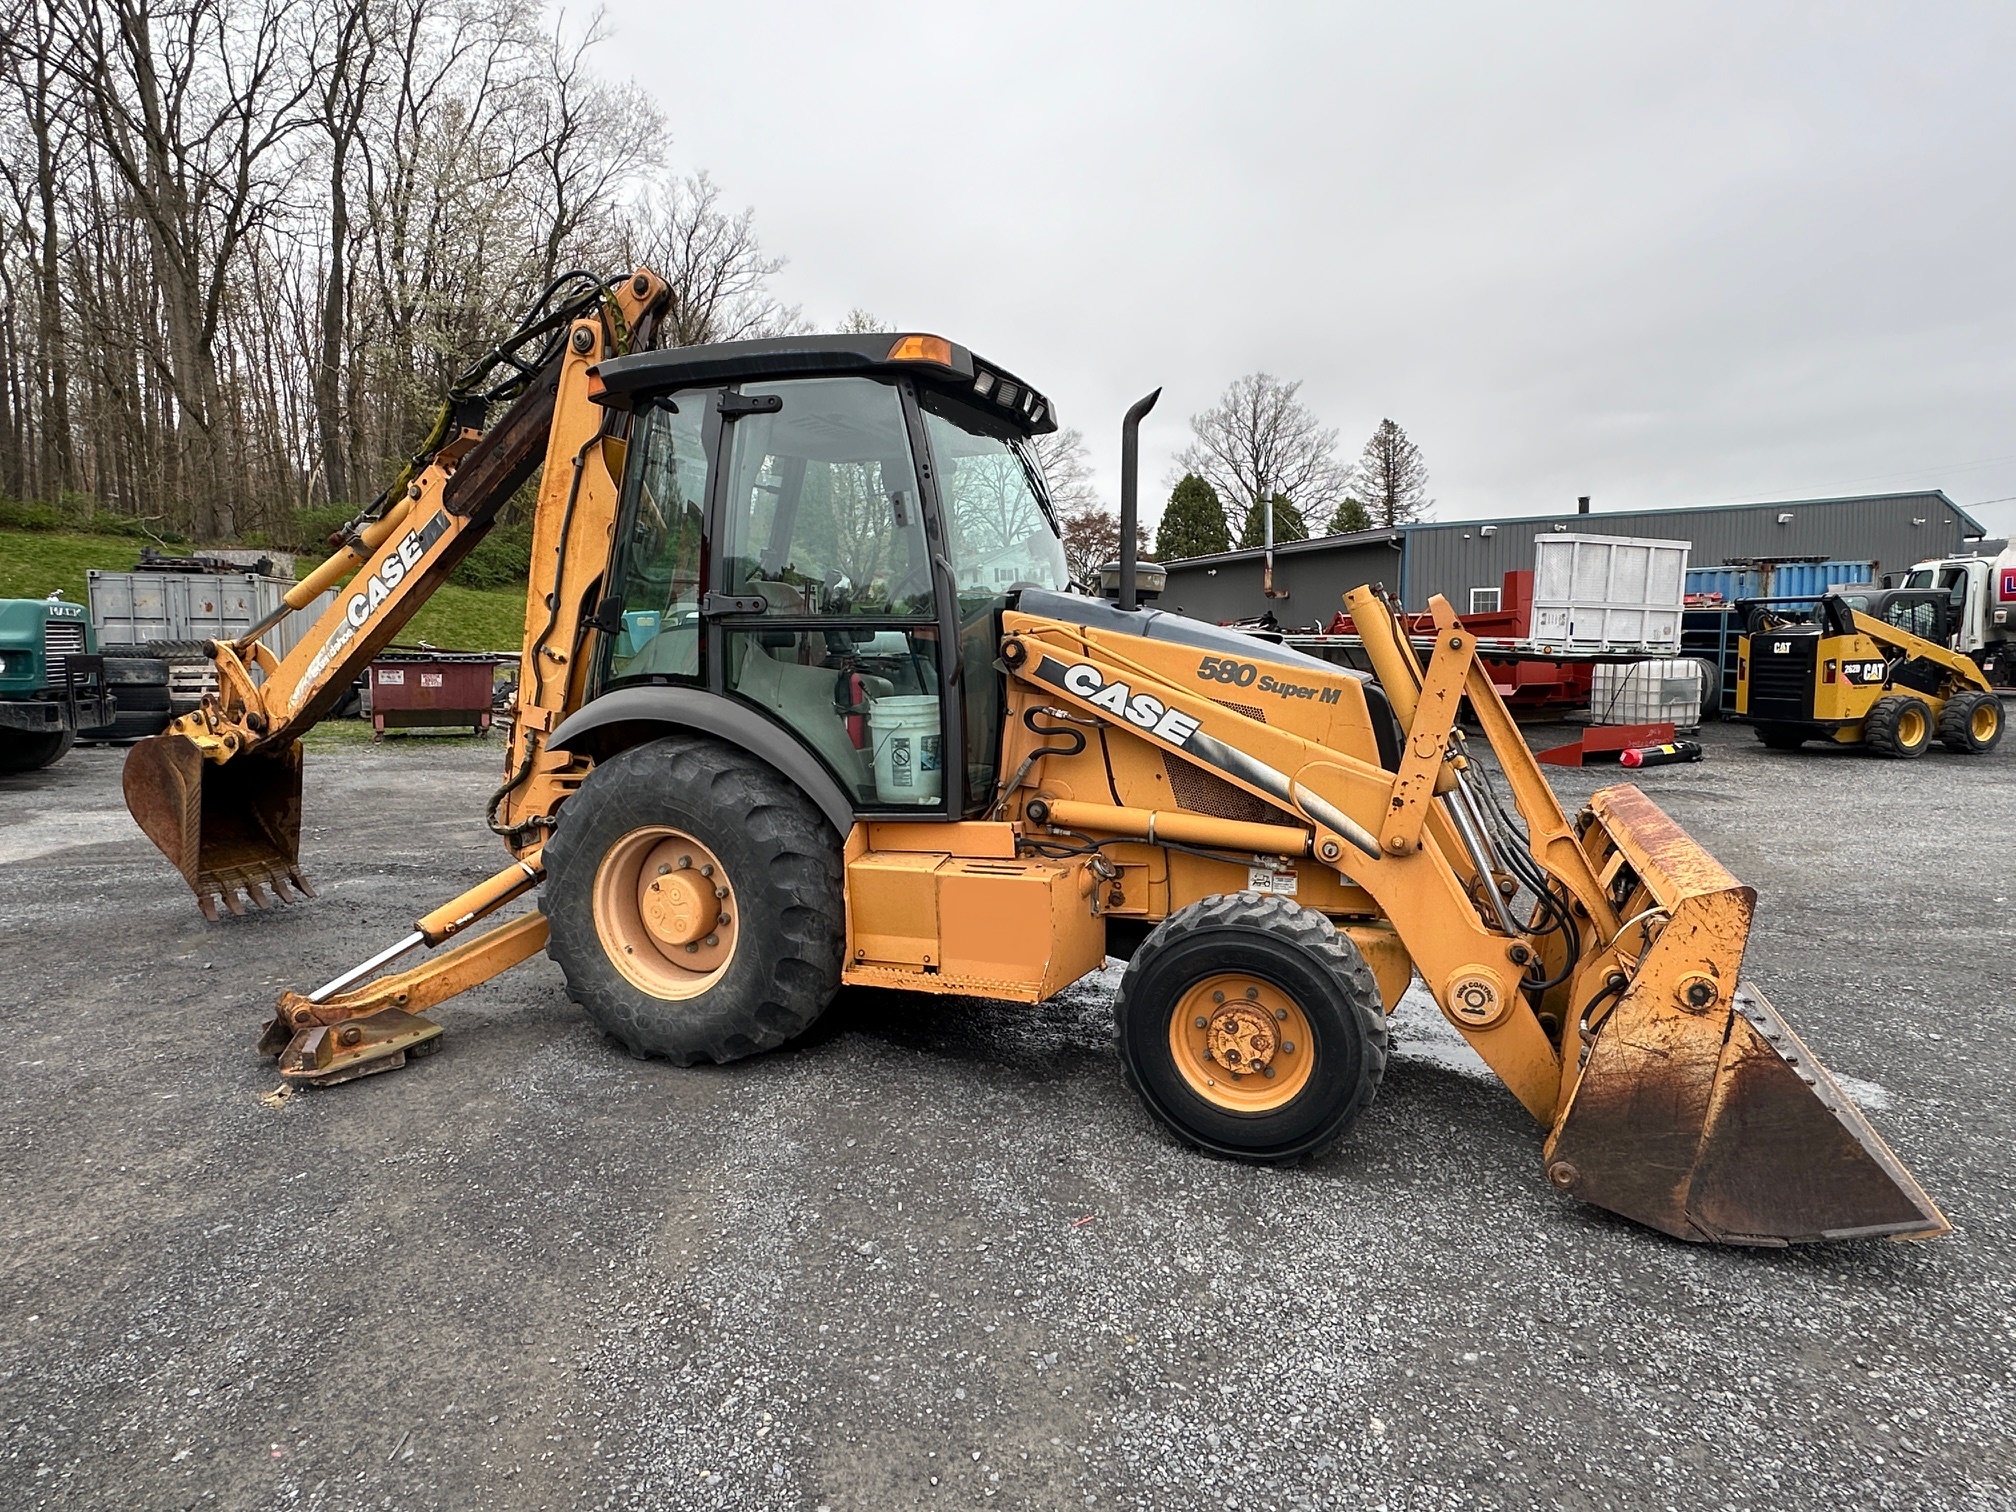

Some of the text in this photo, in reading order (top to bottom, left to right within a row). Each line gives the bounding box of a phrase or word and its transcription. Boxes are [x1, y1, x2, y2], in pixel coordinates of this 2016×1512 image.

[346, 529, 424, 628] CASE
[1773, 641, 1792, 654] CAT
[1197, 656, 1343, 705] 580 Super M
[1863, 662, 1886, 681] CAT
[1063, 663, 1202, 747] CASE
[1468, 981, 1494, 1003] CONTROL
